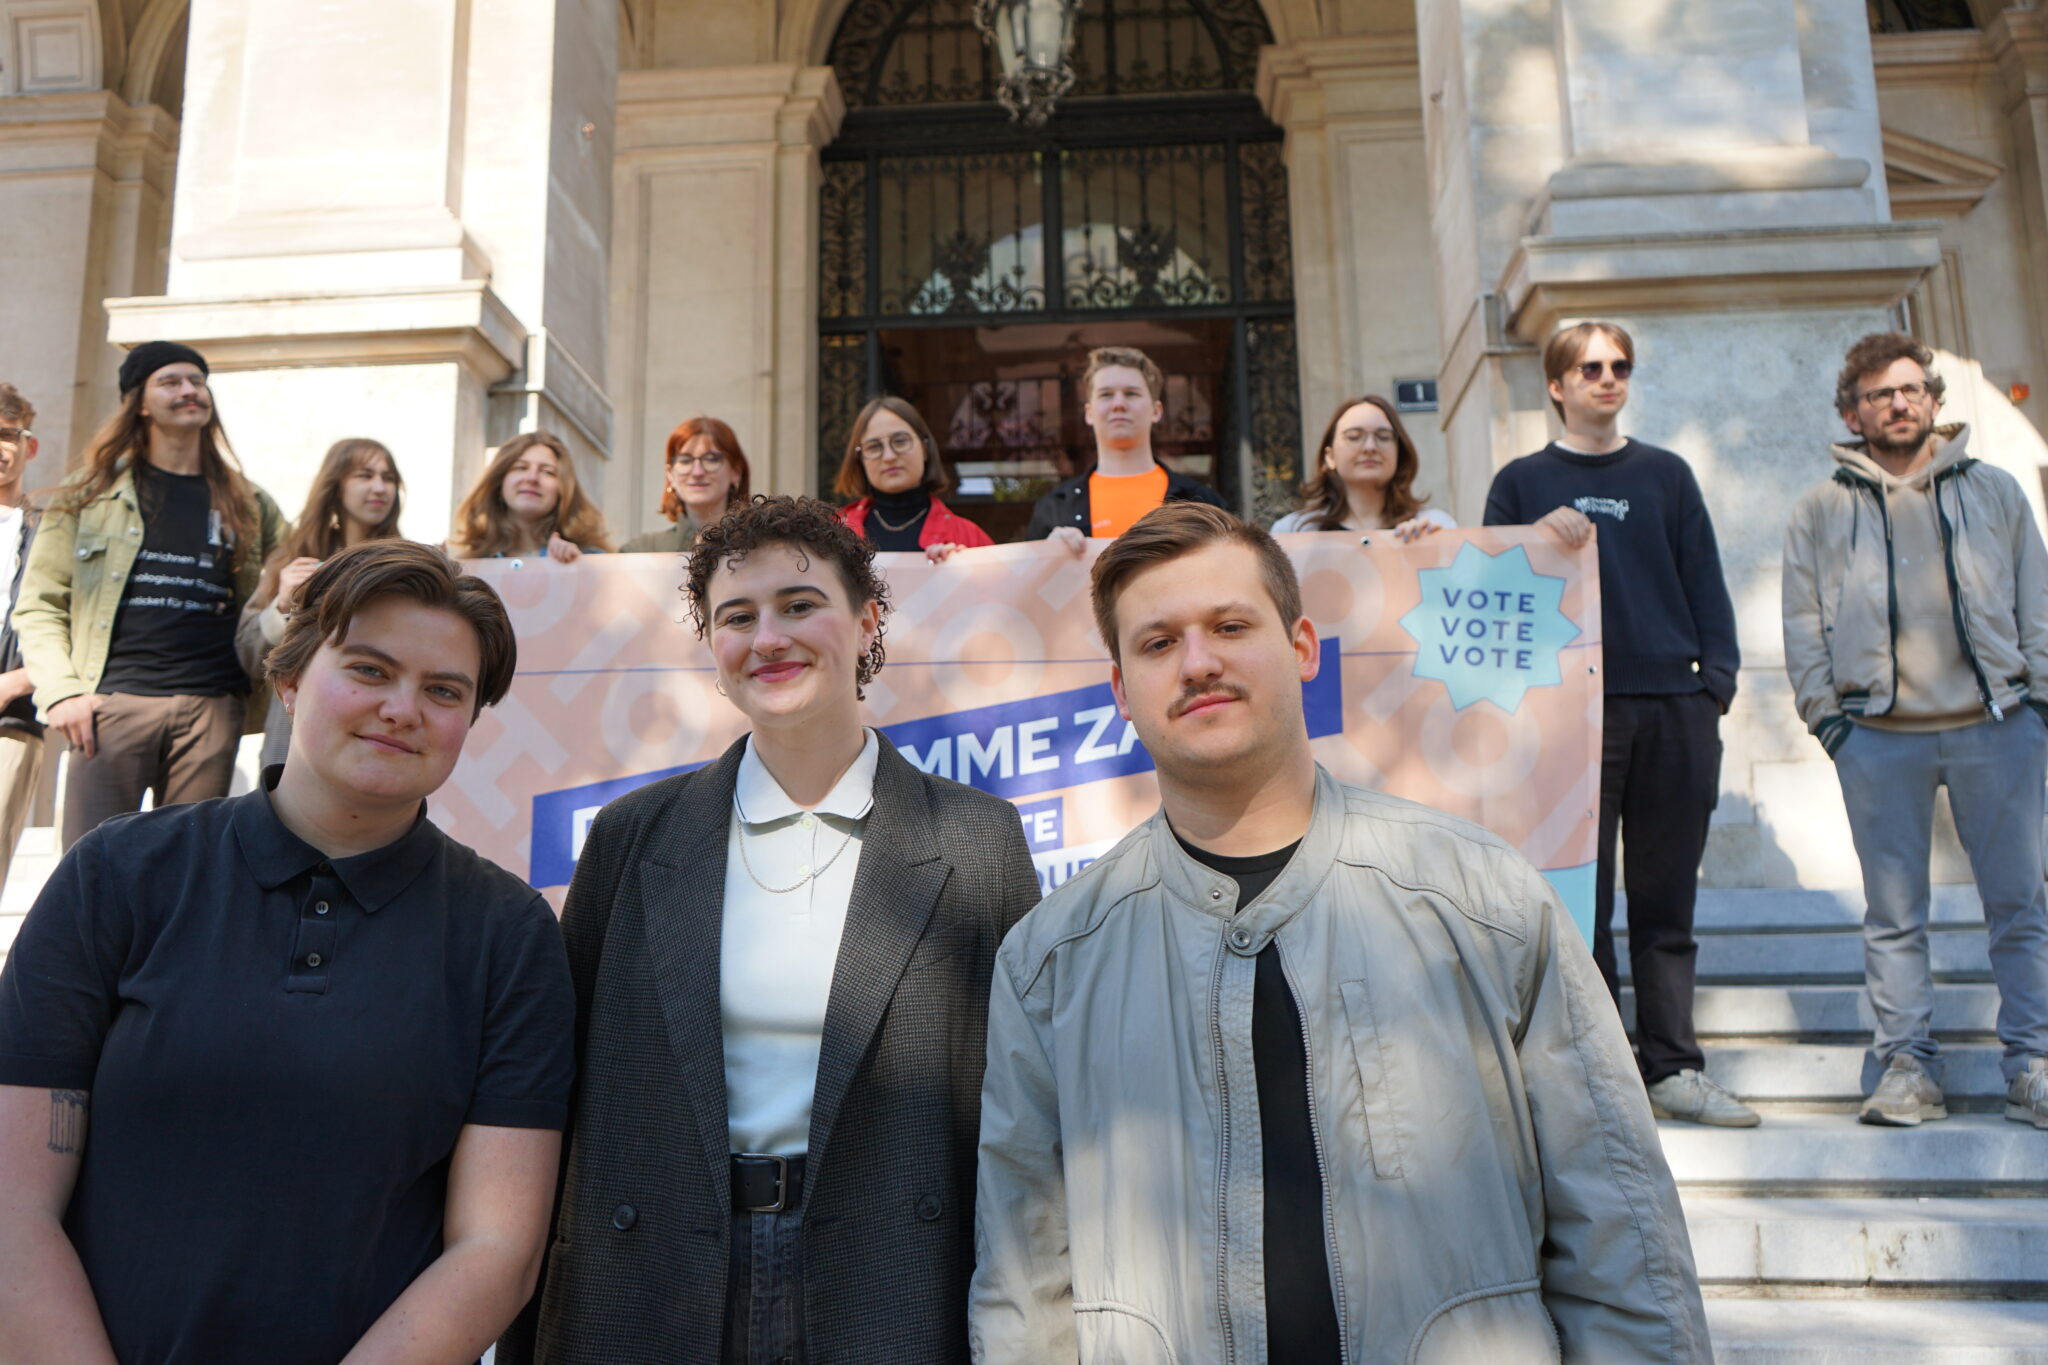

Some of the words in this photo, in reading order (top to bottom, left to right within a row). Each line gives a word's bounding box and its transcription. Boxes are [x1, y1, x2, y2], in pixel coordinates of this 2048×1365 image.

[1415, 383, 1424, 401] 1
[1442, 587, 1536, 614] VOTE
[1440, 616, 1534, 643] VOTE
[1438, 643, 1533, 670] VOTE
